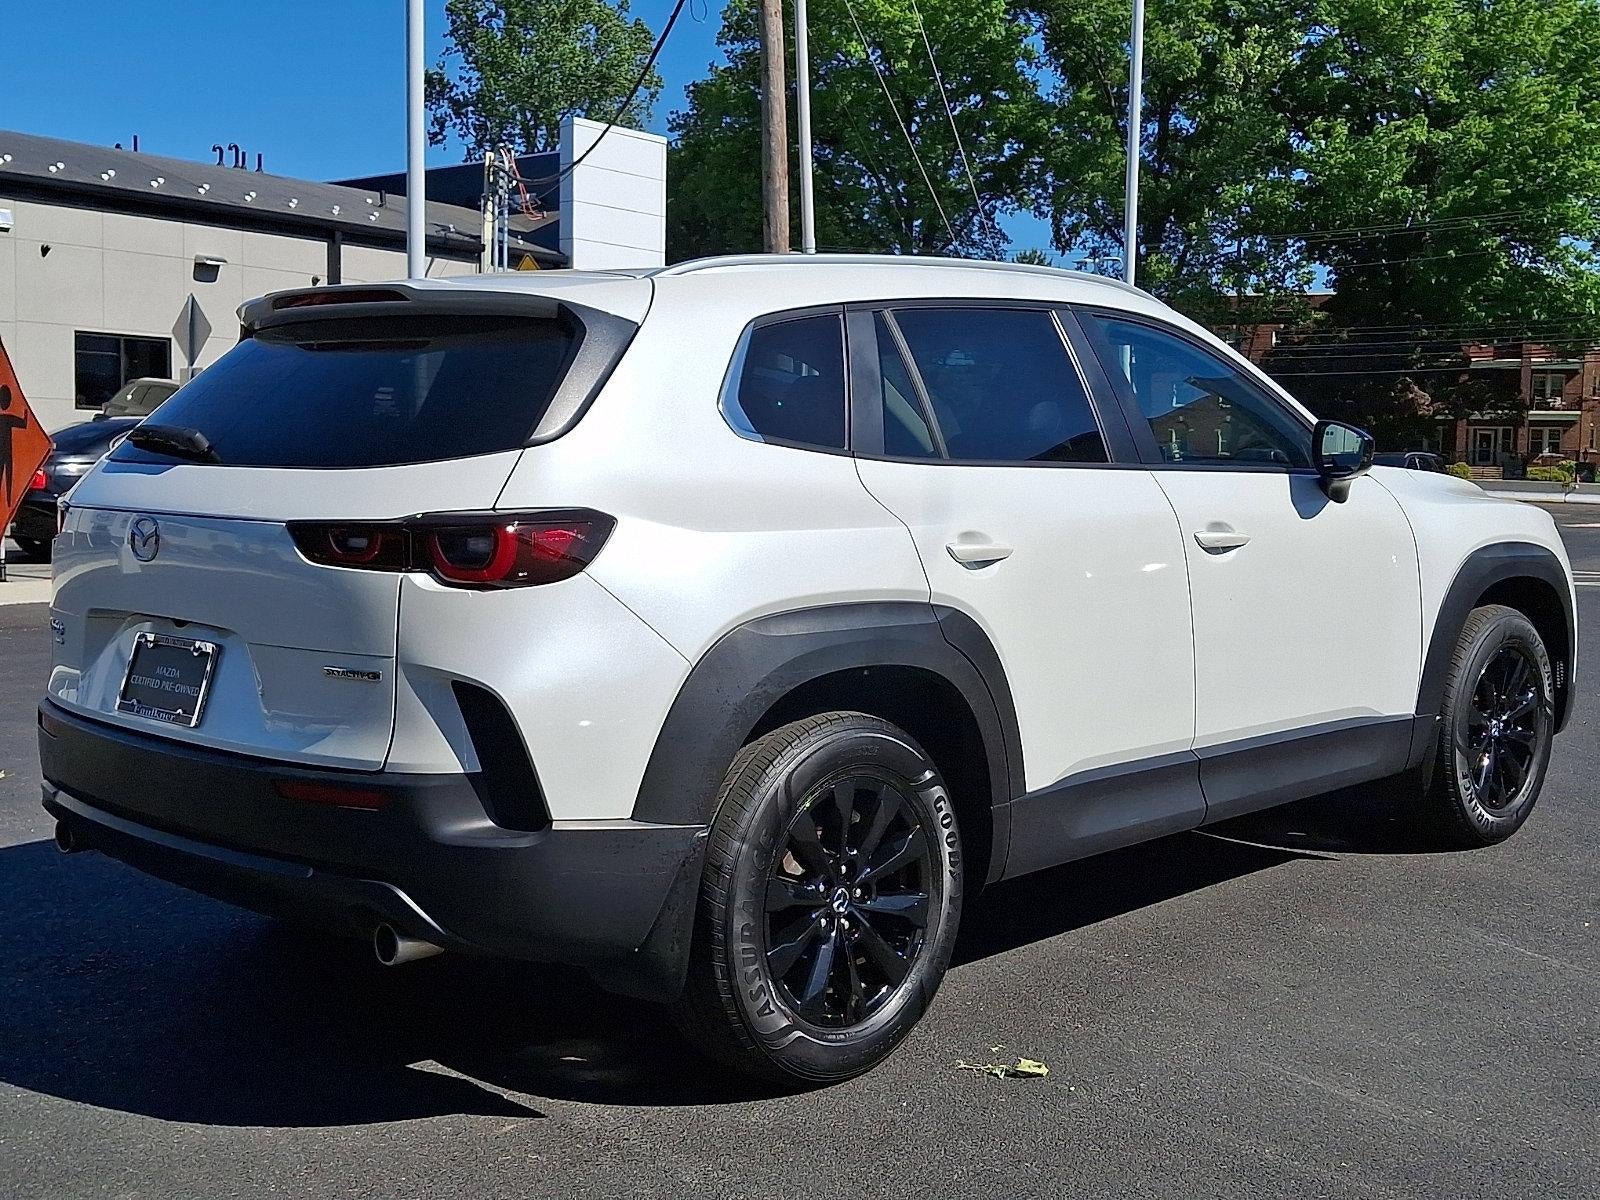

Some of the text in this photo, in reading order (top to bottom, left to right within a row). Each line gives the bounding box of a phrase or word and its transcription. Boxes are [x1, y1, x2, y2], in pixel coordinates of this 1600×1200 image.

[155, 665, 181, 678] MAZDA
[130, 674, 200, 697] CERTIFIED PRE-OWNED
[133, 703, 176, 722] Faulkner
